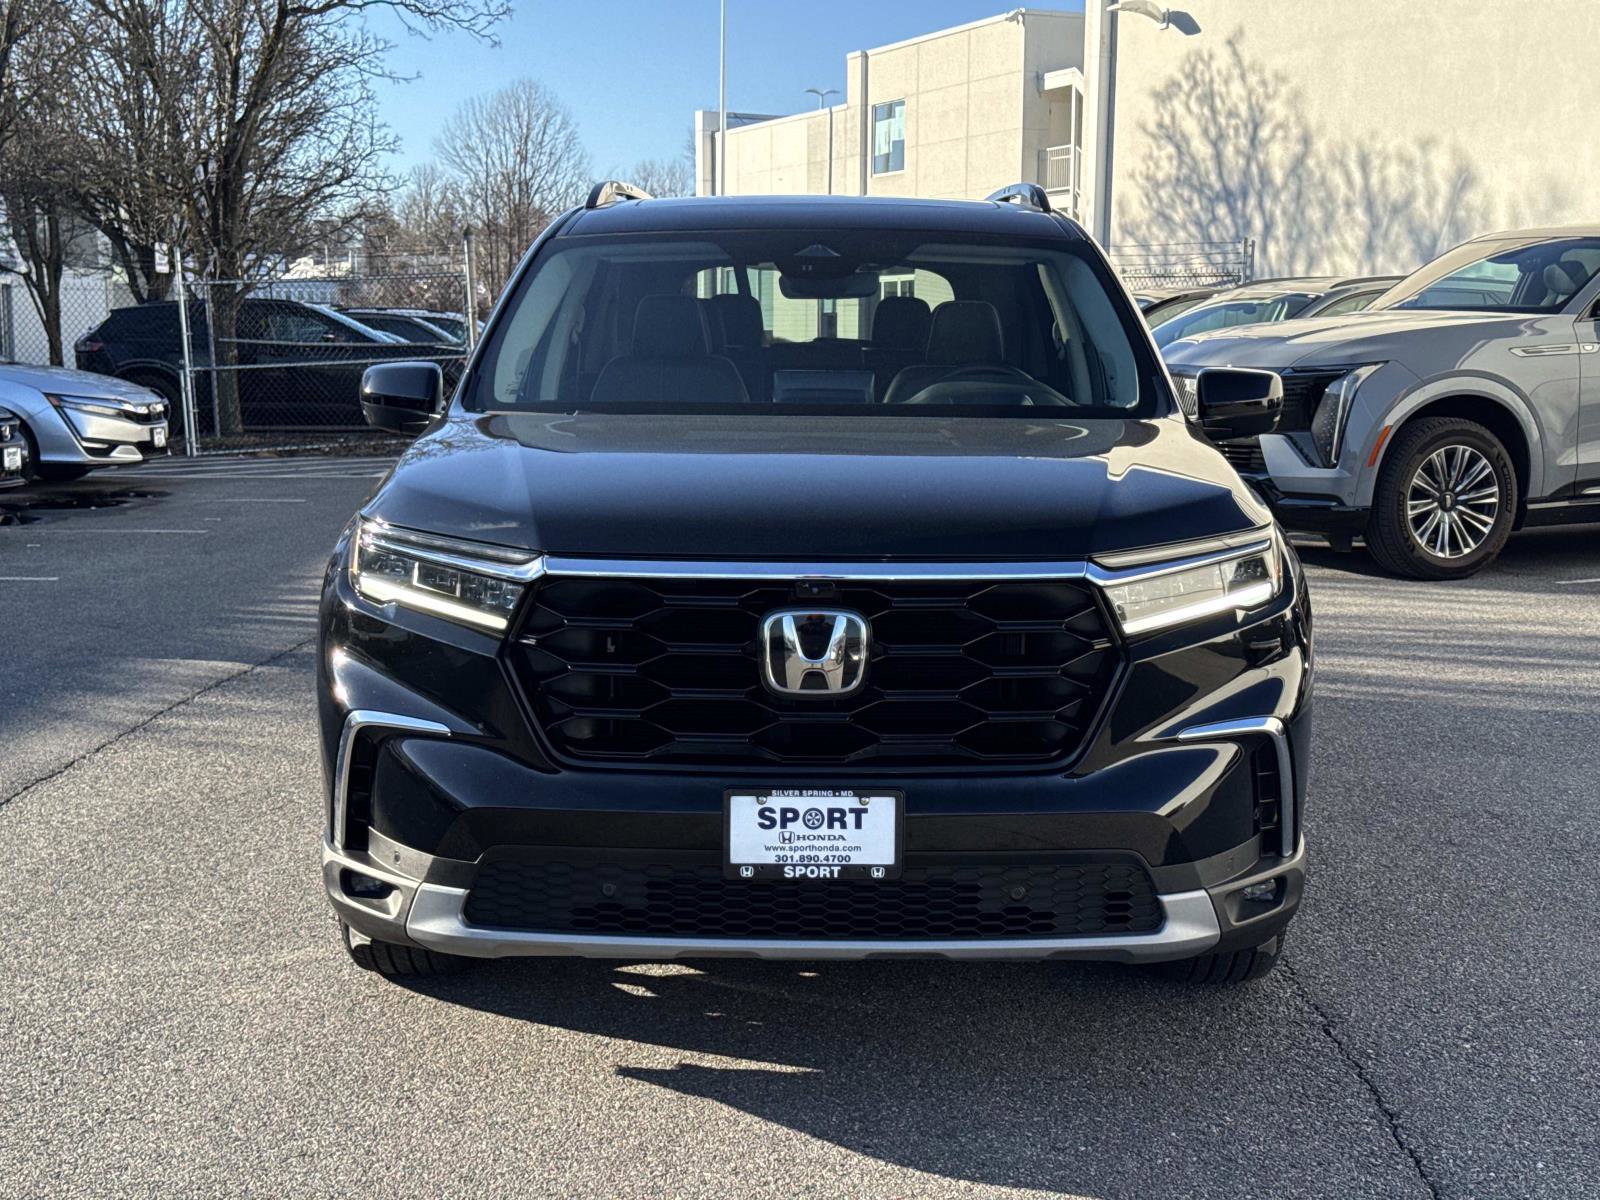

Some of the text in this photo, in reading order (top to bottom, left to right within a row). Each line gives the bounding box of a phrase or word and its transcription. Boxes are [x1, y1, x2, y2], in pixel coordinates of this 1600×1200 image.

[757, 807, 868, 830] SPORT
[796, 834, 847, 842] HONDA
[764, 844, 862, 854] www.sporthonda.com
[774, 855, 851, 863] 301.890.4700
[783, 866, 842, 878] SPORT
